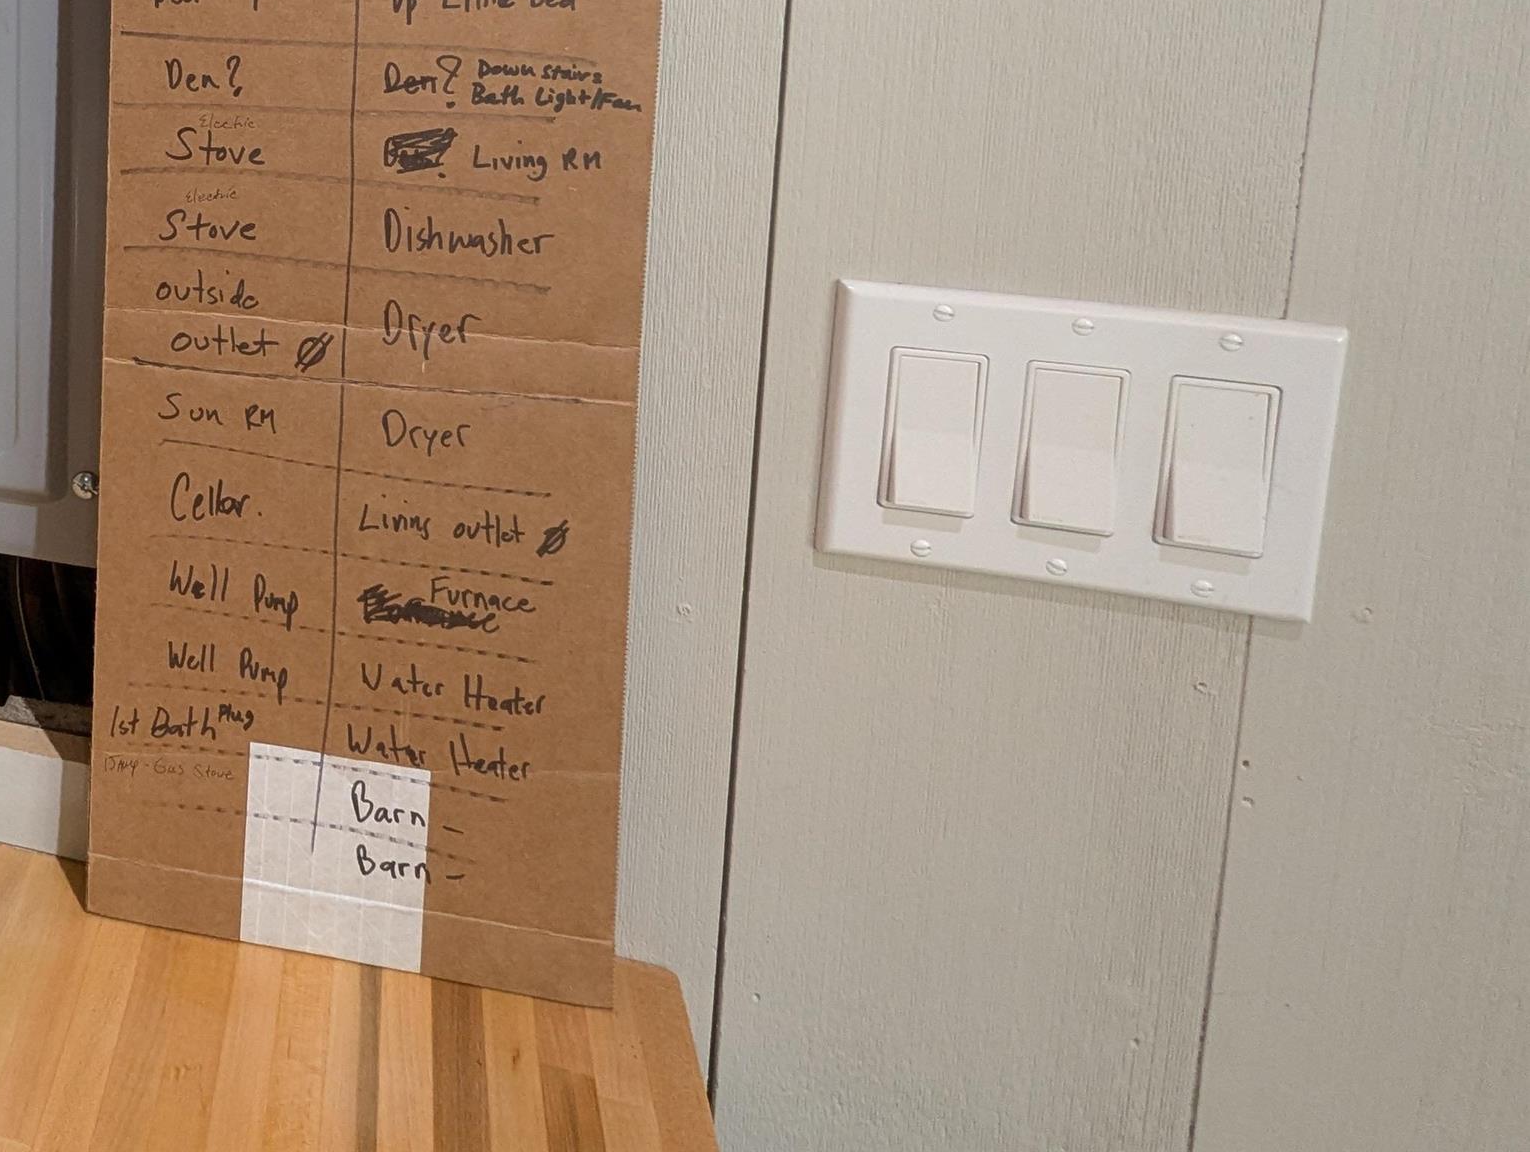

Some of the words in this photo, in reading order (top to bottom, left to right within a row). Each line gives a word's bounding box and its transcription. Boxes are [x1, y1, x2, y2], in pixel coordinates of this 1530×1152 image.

[165, 55, 244, 98] Den?
[471, 82, 526, 106] Bath
[166, 127, 266, 166] Stove
[472, 139, 548, 181] Living
[159, 209, 257, 241] Stove
[384, 206, 555, 258] Dishwasher
[383, 299, 483, 361] Dryer
[158, 392, 224, 426] Sun
[381, 409, 471, 457] Dryer
[170, 560, 229, 603] Well
[253, 573, 299, 632] Pump
[430, 575, 536, 613] Furnace
[168, 641, 216, 673] Well
[239, 647, 288, 706] Pump
[464, 673, 546, 716] Heater
[150, 705, 217, 740] Bath
[347, 723, 427, 767] Water
[449, 732, 531, 780] Heater
[351, 780, 426, 828] Barn
[356, 844, 432, 885] Barn
